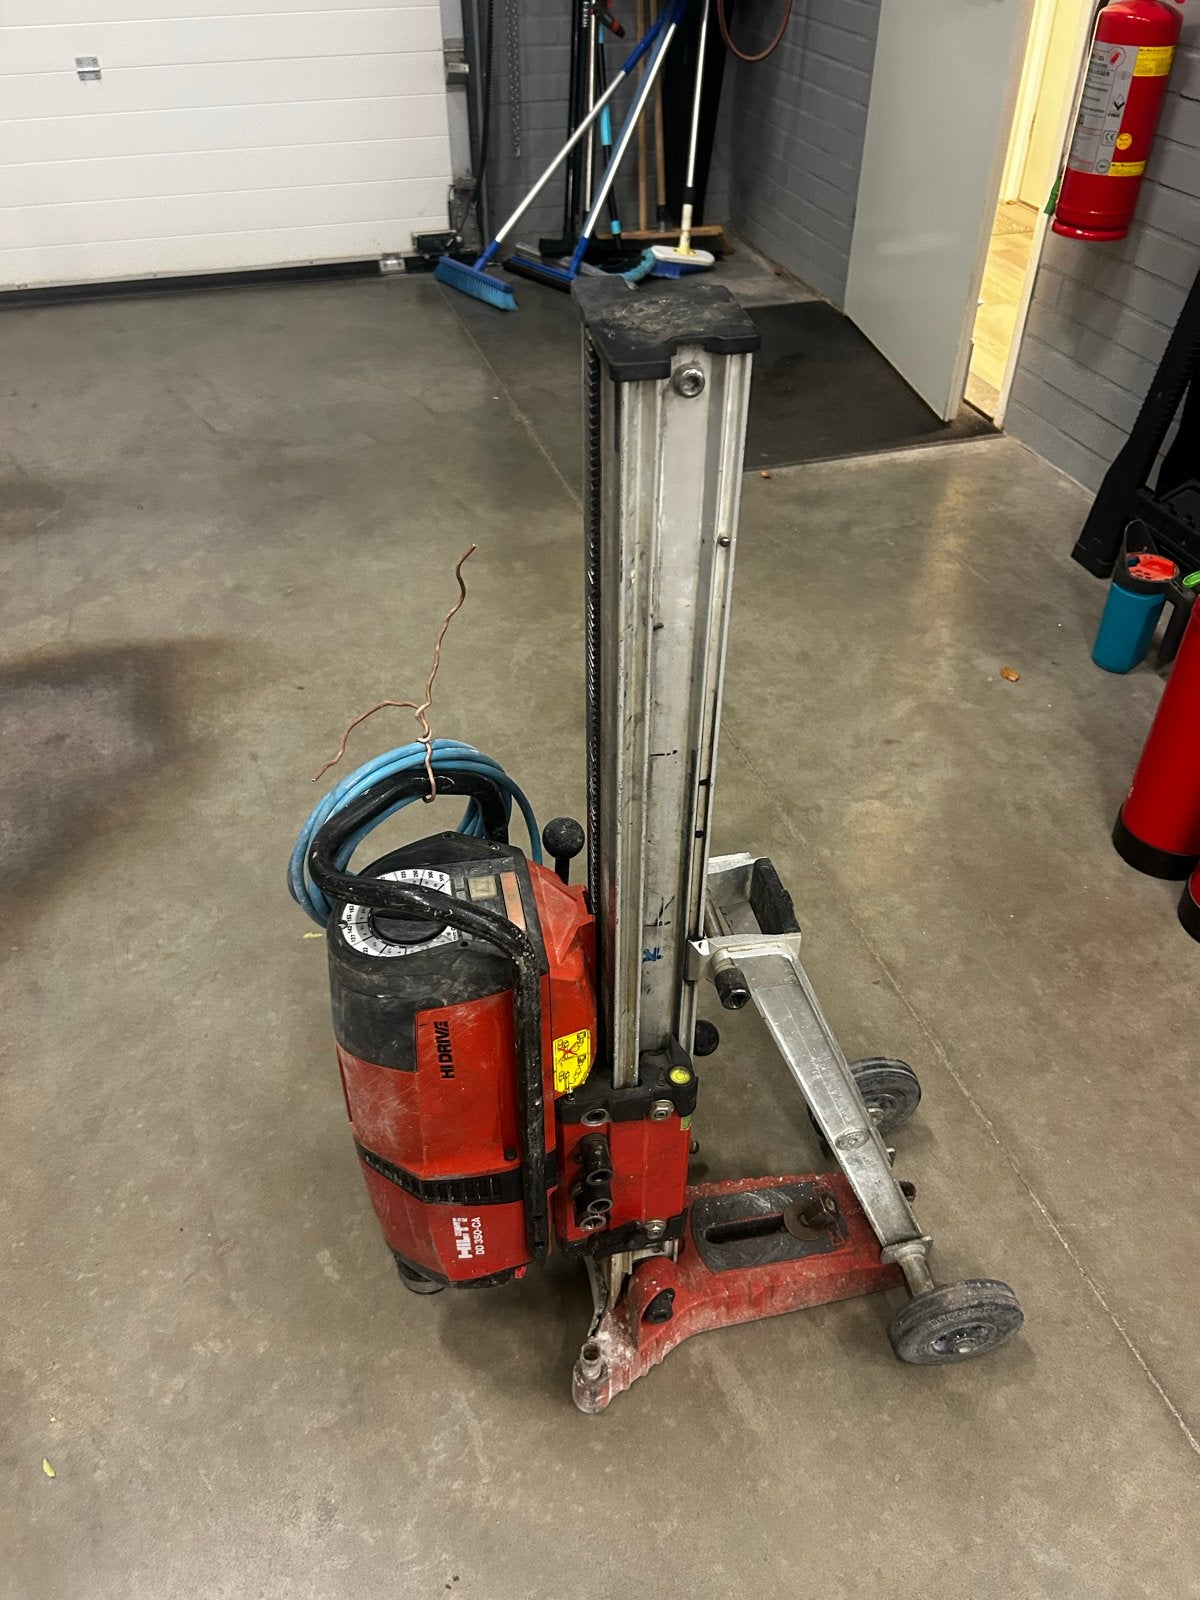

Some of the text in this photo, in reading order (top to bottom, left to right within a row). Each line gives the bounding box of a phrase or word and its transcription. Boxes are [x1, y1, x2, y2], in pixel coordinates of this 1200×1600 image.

[452, 1217, 473, 1259] HILTI
[471, 1216, 485, 1255] DD 350-CA
